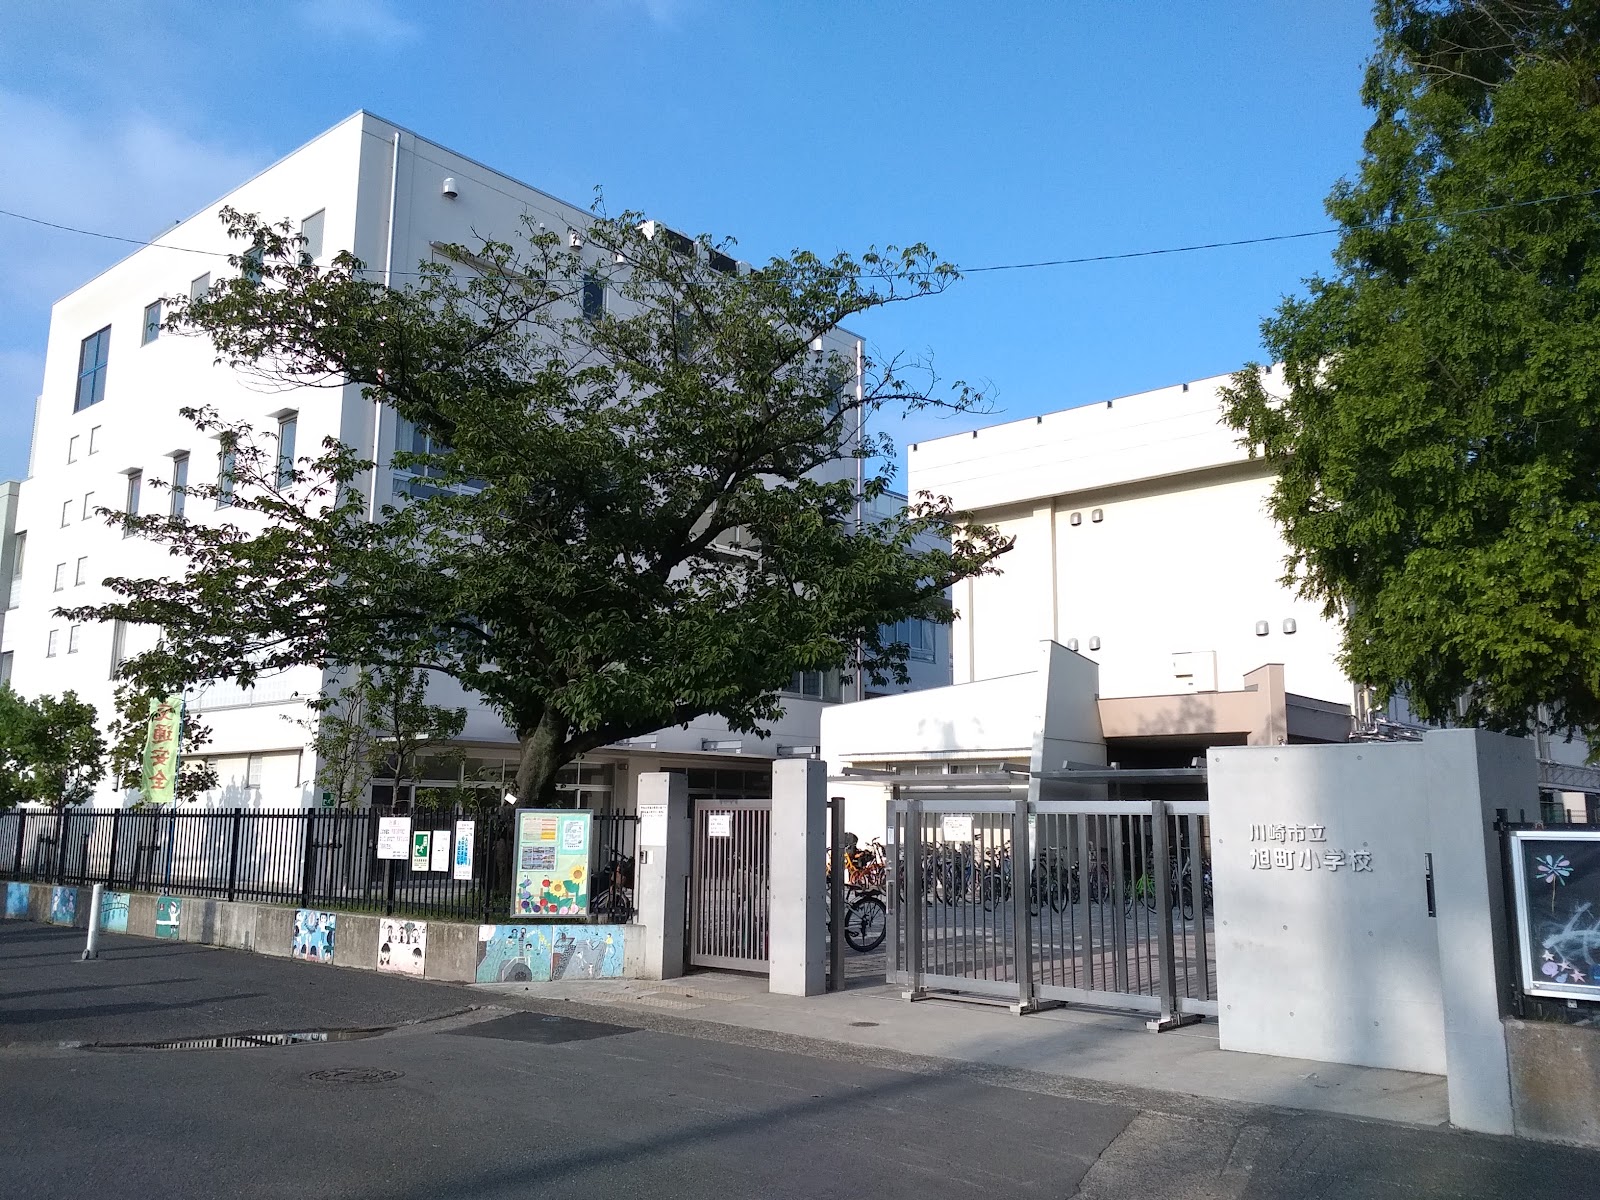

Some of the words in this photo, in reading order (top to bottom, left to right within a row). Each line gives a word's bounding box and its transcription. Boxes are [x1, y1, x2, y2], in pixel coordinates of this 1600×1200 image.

[1249, 823, 1327, 842] 川崎市立
[1250, 848, 1373, 872] 旭町小学校
